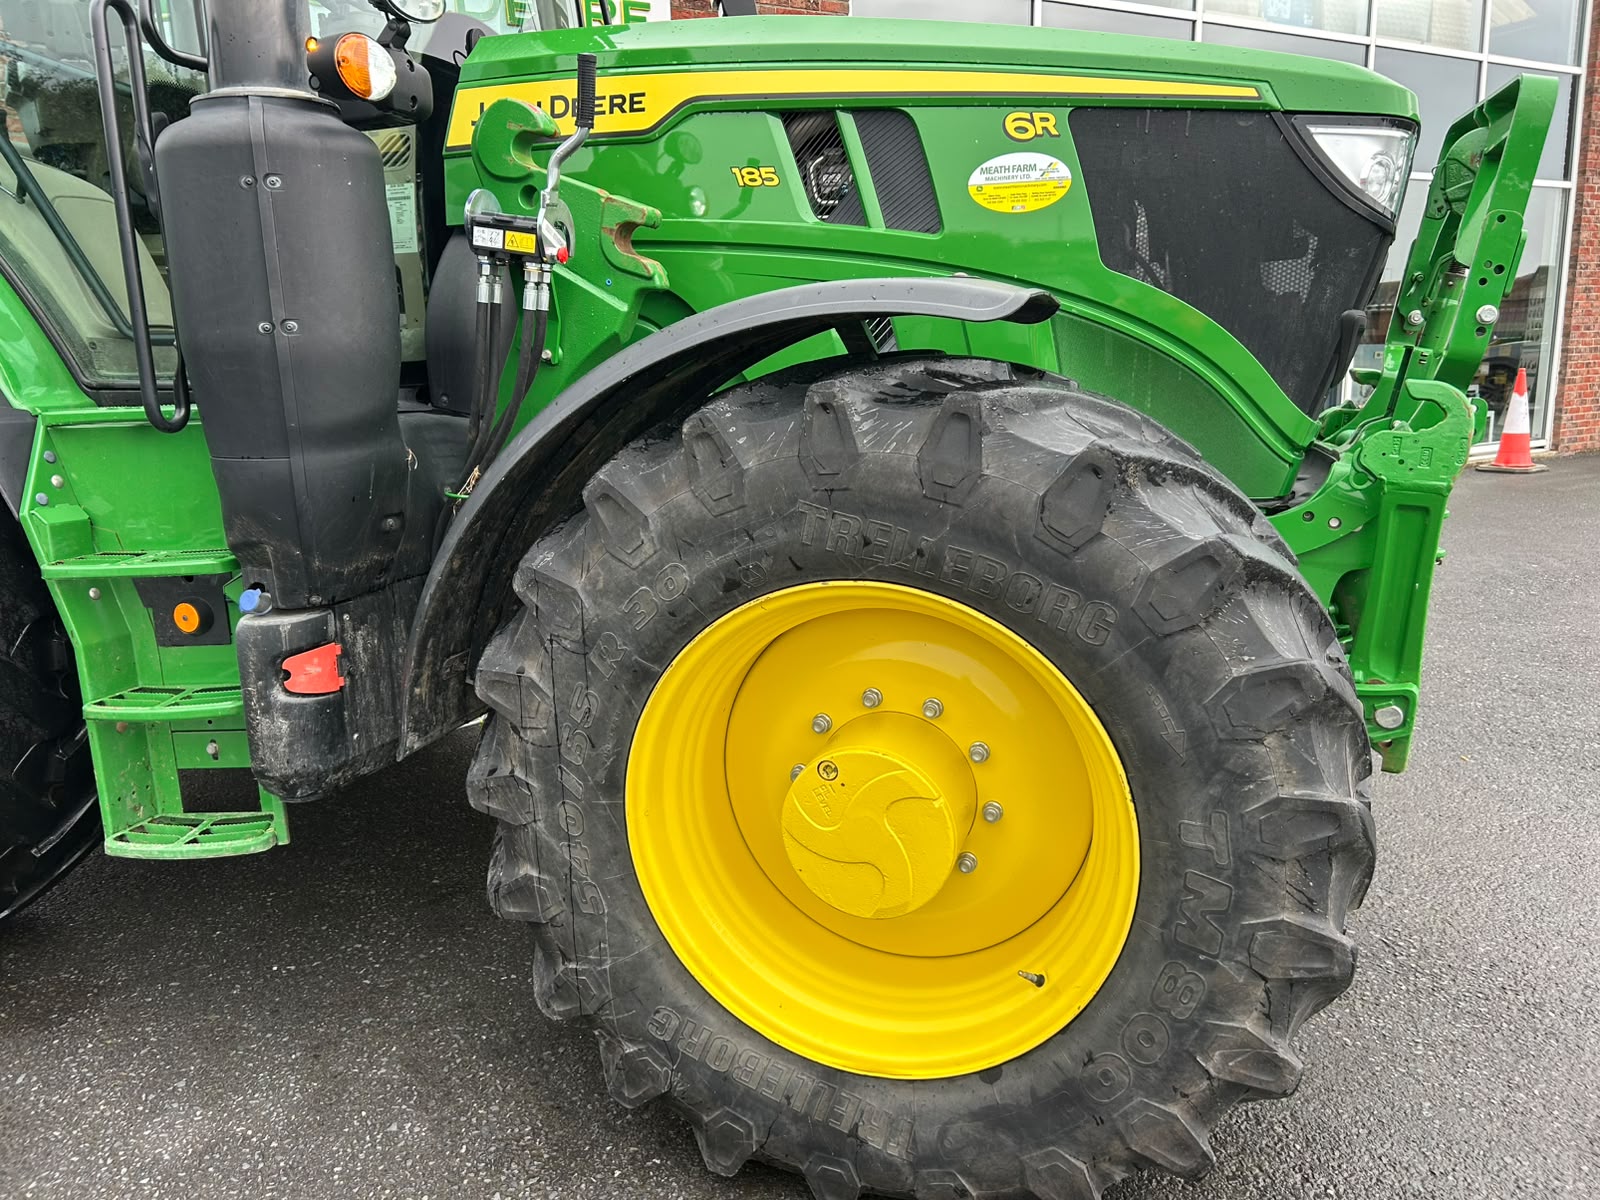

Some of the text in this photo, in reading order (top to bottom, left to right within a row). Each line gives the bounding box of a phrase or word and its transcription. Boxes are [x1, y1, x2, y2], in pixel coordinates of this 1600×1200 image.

[1002, 111, 1060, 142] 6R
[730, 166, 780, 187] 185
[980, 165, 1011, 176] MEATH
[1011, 163, 1037, 173] FARM
[985, 174, 1019, 182] MACHINERY
[798, 499, 1119, 646] TRELLEBORG
[590, 631, 629, 681] R
[623, 562, 689, 632] 30
[647, 1005, 914, 1162] TRELLEBORG
